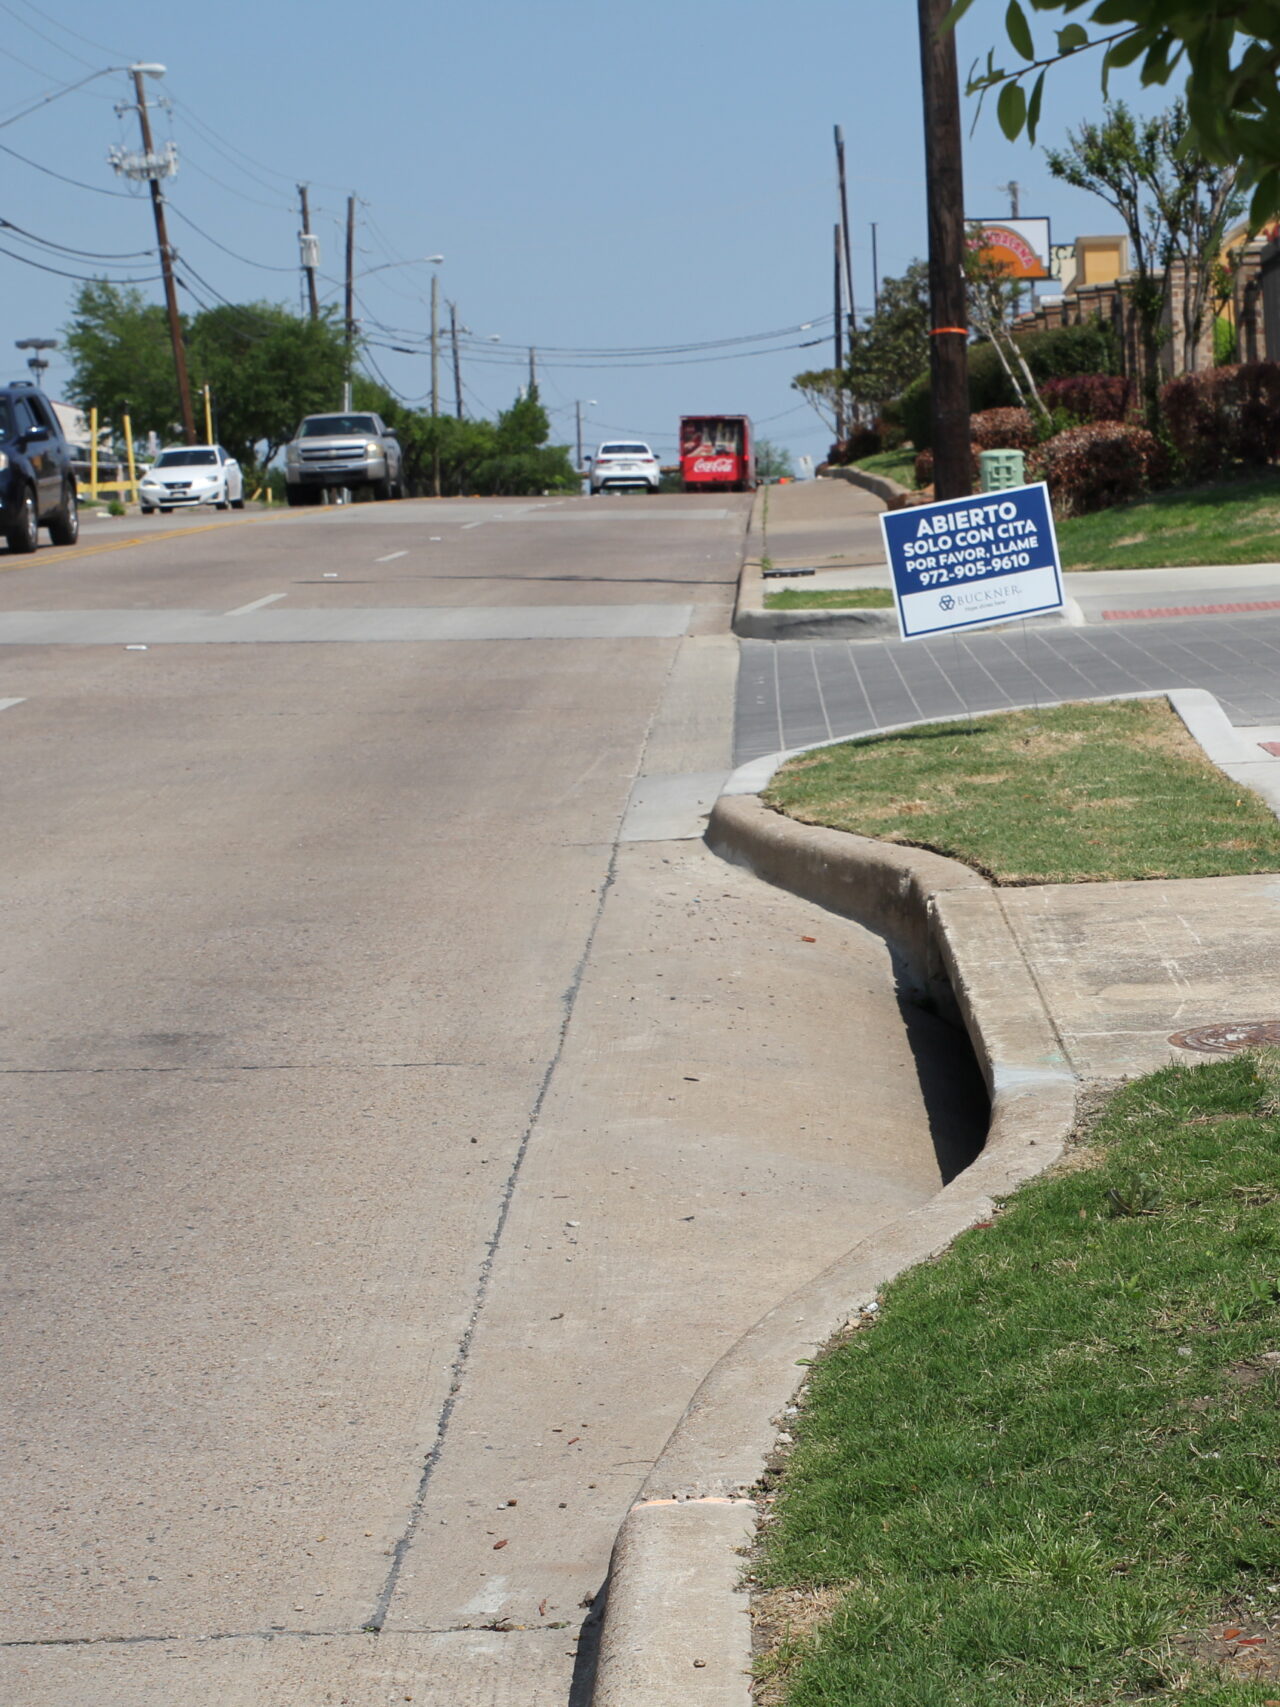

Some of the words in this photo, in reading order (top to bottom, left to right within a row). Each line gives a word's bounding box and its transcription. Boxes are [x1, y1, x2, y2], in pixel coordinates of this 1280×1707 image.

[917, 502, 1017, 537] ABIERTO
[903, 535, 952, 557] SOLO
[955, 527, 995, 547] CON
[997, 519, 1038, 539] CITA
[906, 557, 937, 572] POR
[939, 547, 990, 567] FAVOR,
[992, 536, 1039, 556] LLAME
[919, 552, 1030, 586] 972-905-9610
